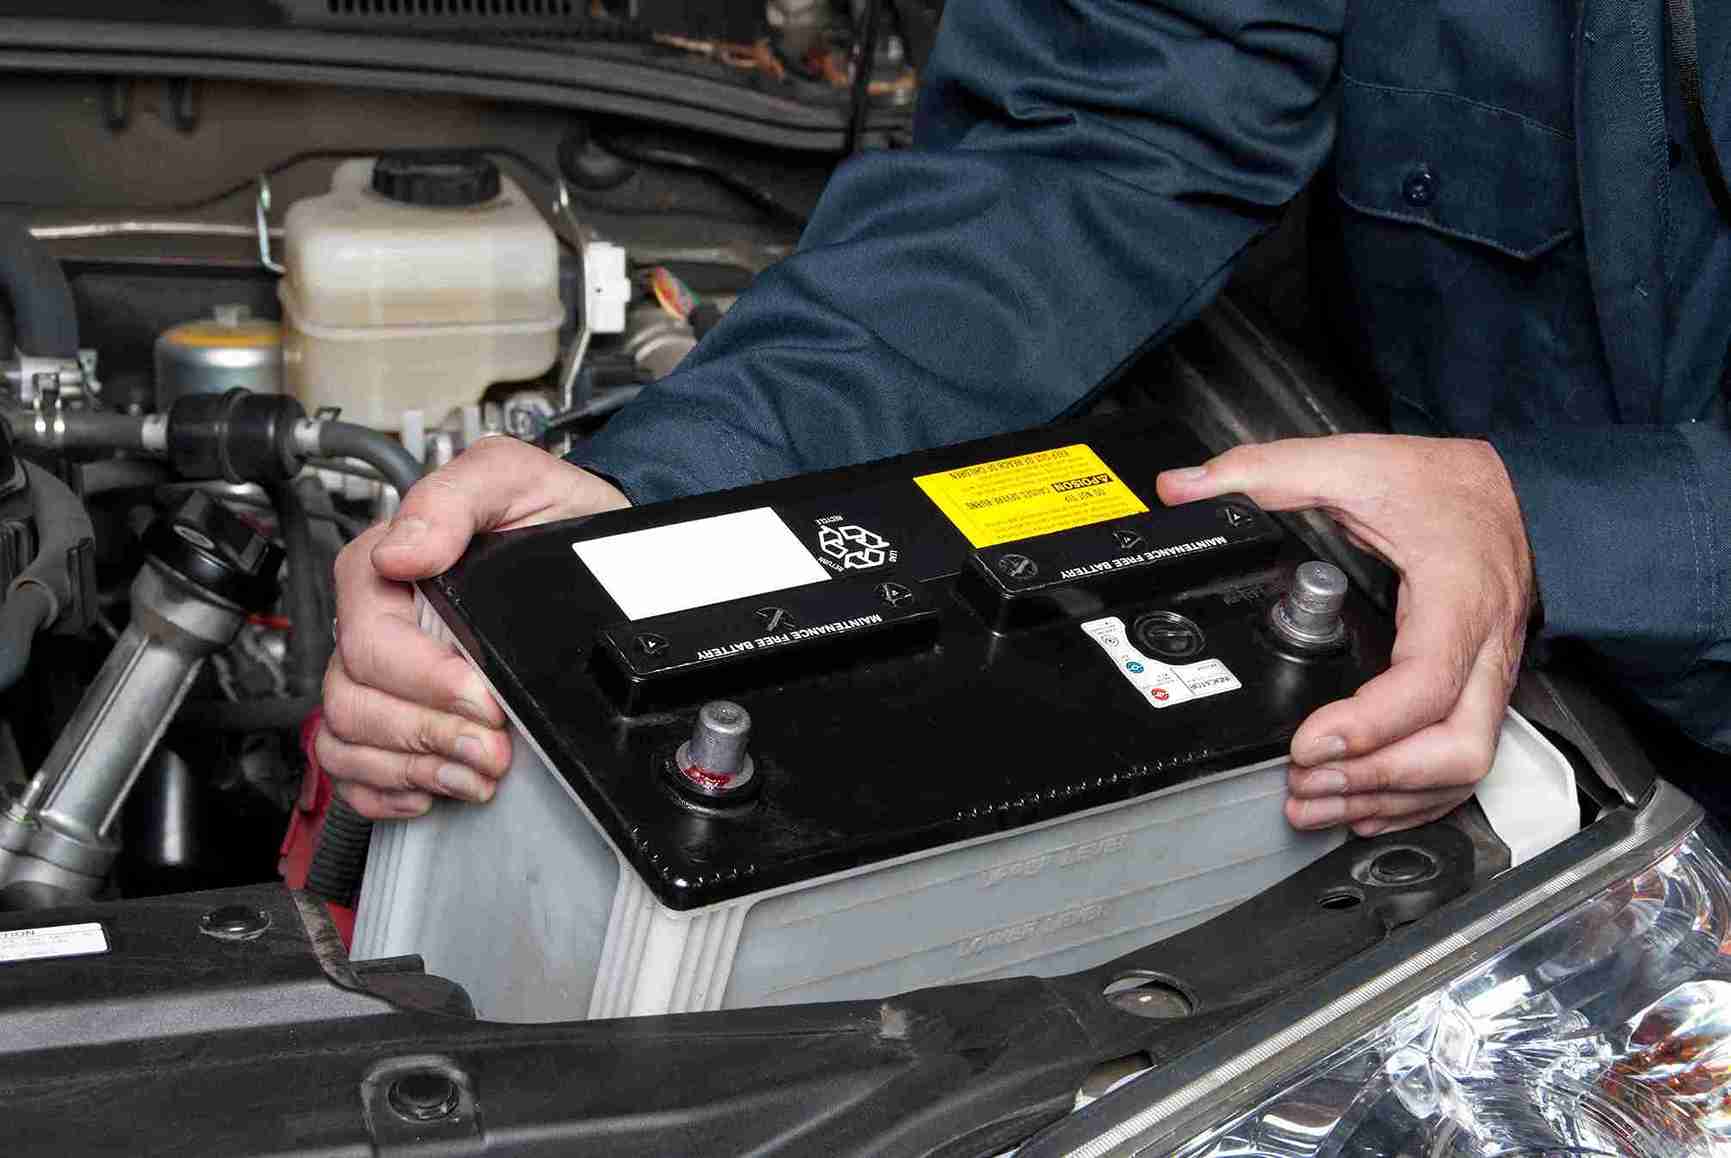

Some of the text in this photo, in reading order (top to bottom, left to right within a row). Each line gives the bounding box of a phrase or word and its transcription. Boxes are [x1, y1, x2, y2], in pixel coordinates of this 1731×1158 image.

[1054, 476, 1098, 491] POISON
[1060, 535, 1227, 580] MAINTENANCE FREE BATTERY
[695, 613, 882, 660] MAINTENANCE FREE BATTERY
